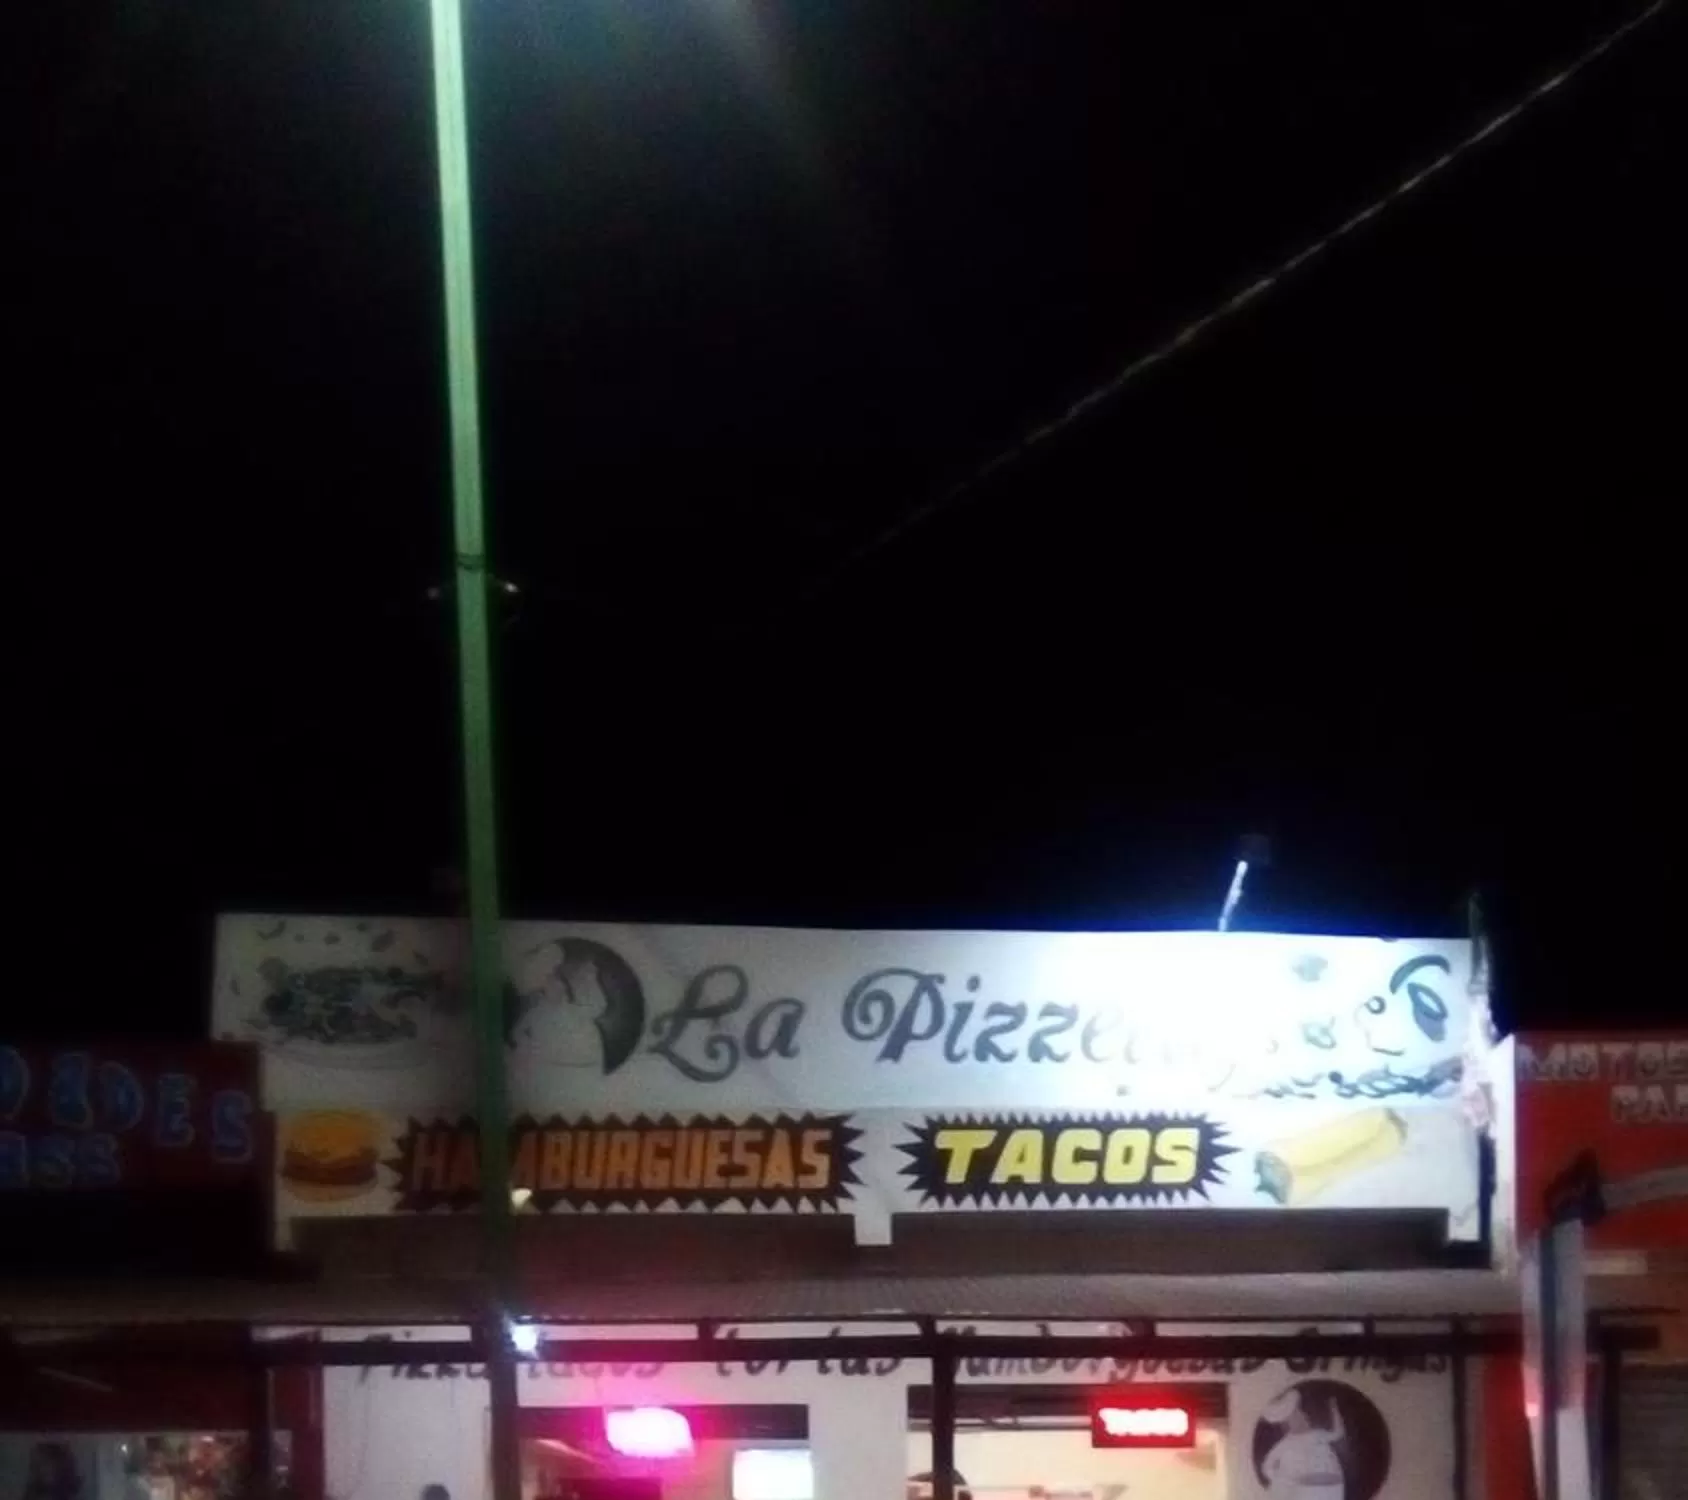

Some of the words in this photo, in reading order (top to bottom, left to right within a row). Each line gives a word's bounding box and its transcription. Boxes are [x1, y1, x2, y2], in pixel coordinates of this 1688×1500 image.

[648, 964, 806, 1083] La
[842, 966, 1208, 1065] Pizze
[933, 1127, 1200, 1185] TACOS
